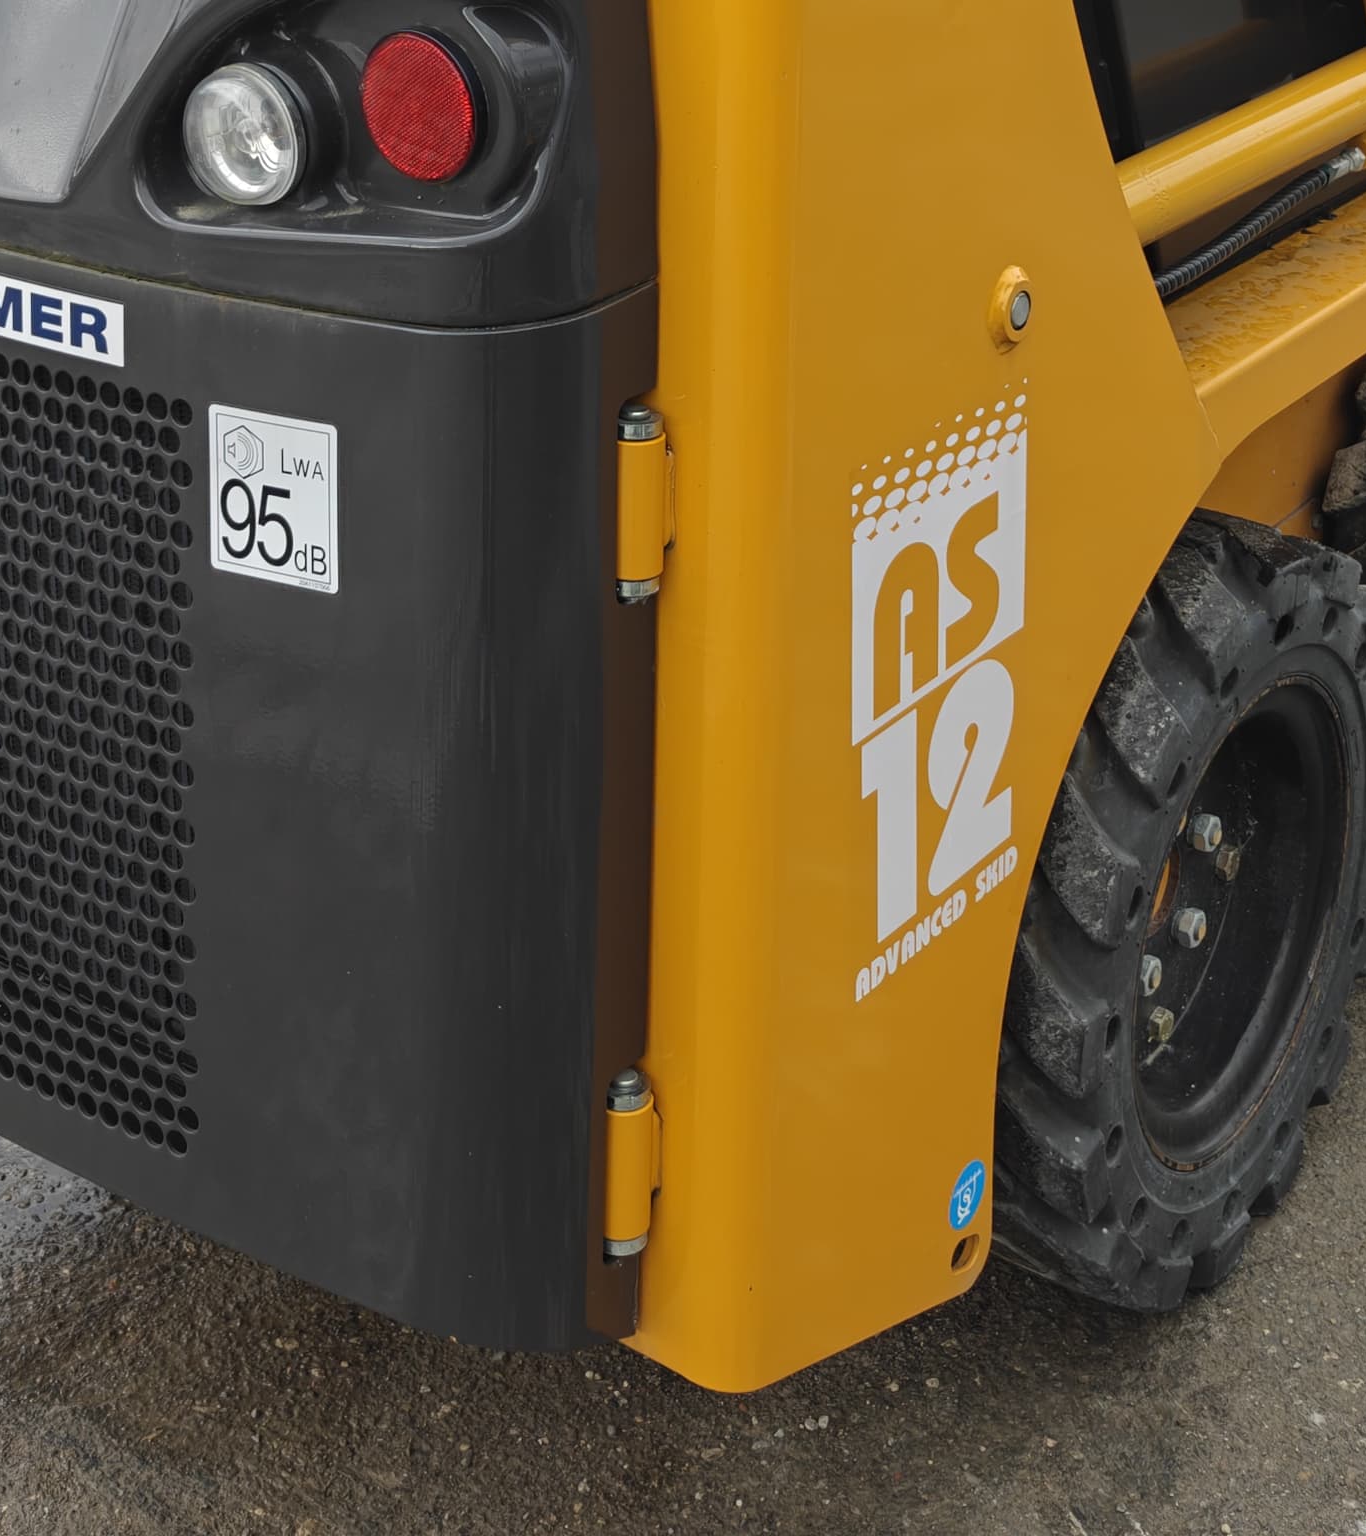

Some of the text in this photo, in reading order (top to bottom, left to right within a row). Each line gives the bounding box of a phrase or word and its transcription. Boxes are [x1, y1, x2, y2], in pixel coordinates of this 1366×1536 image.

[872, 490, 1002, 714] AS
[860, 658, 1014, 944] 12
[854, 844, 1019, 1004] ADVANCED SKID
